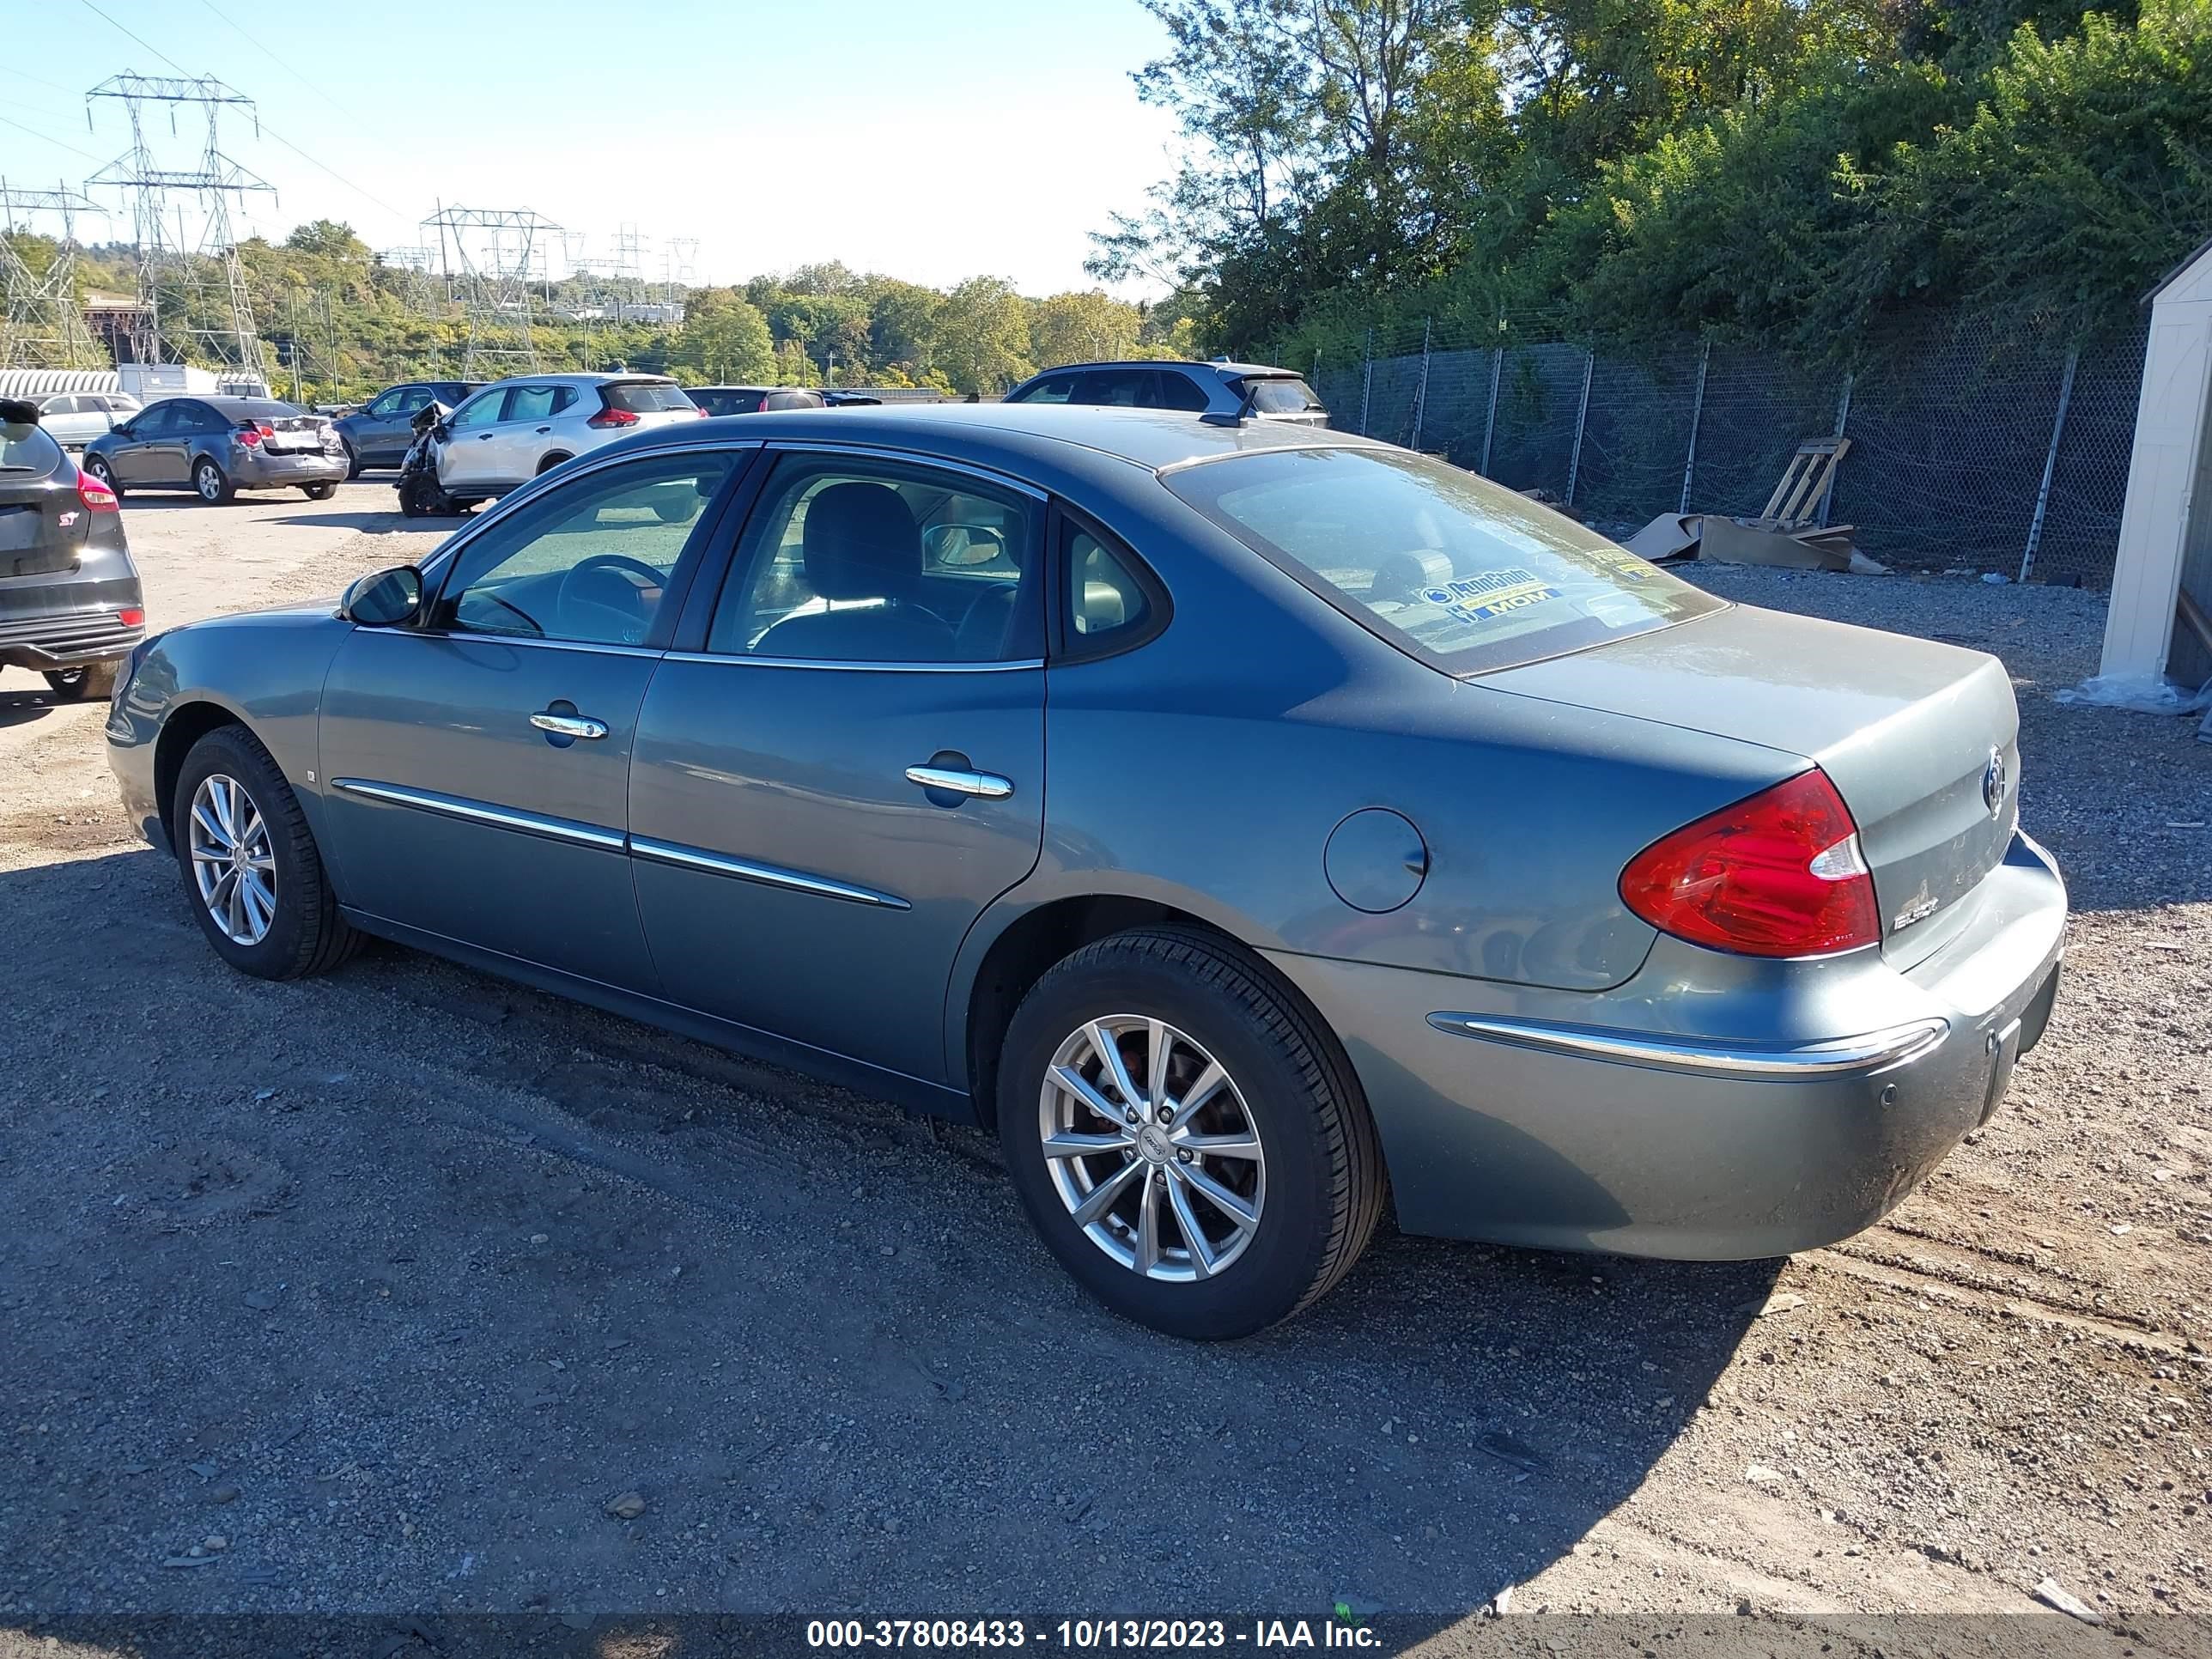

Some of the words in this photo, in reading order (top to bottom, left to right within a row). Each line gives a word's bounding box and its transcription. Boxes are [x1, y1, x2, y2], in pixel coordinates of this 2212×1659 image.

[59, 512, 79, 526] ST
[1488, 590, 1553, 615] MOM
[1143, 1134, 1163, 1156] SPORT
